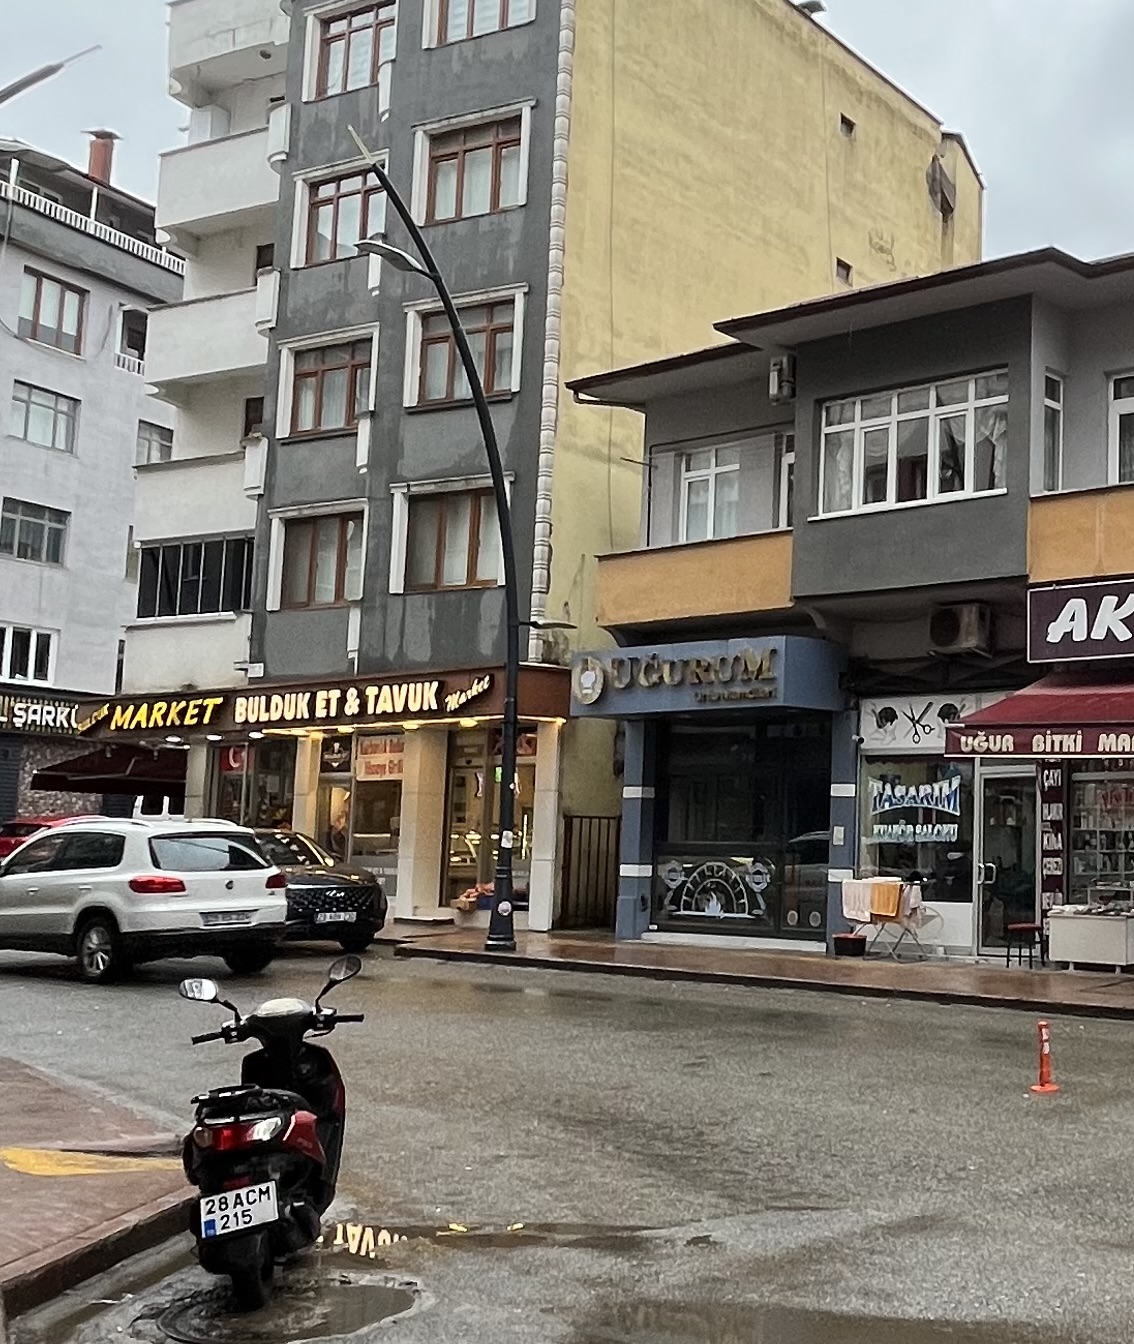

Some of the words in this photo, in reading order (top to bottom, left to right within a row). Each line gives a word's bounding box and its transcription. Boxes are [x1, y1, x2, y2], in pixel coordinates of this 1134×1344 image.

[109, 697, 224, 730] MARKET
[234, 693, 311, 724] BULDUK
[315, 690, 341, 718] ET
[343, 687, 360, 716] &
[365, 680, 439, 715] TAVUK
[960, 731, 1014, 752] UĞUR
[1032, 729, 1082, 753] BİTKİ
[868, 775, 960, 816] TASARIM
[205, 1195, 229, 1216] 28
[233, 1185, 271, 1209] ACM
[220, 1208, 253, 1231] 215
